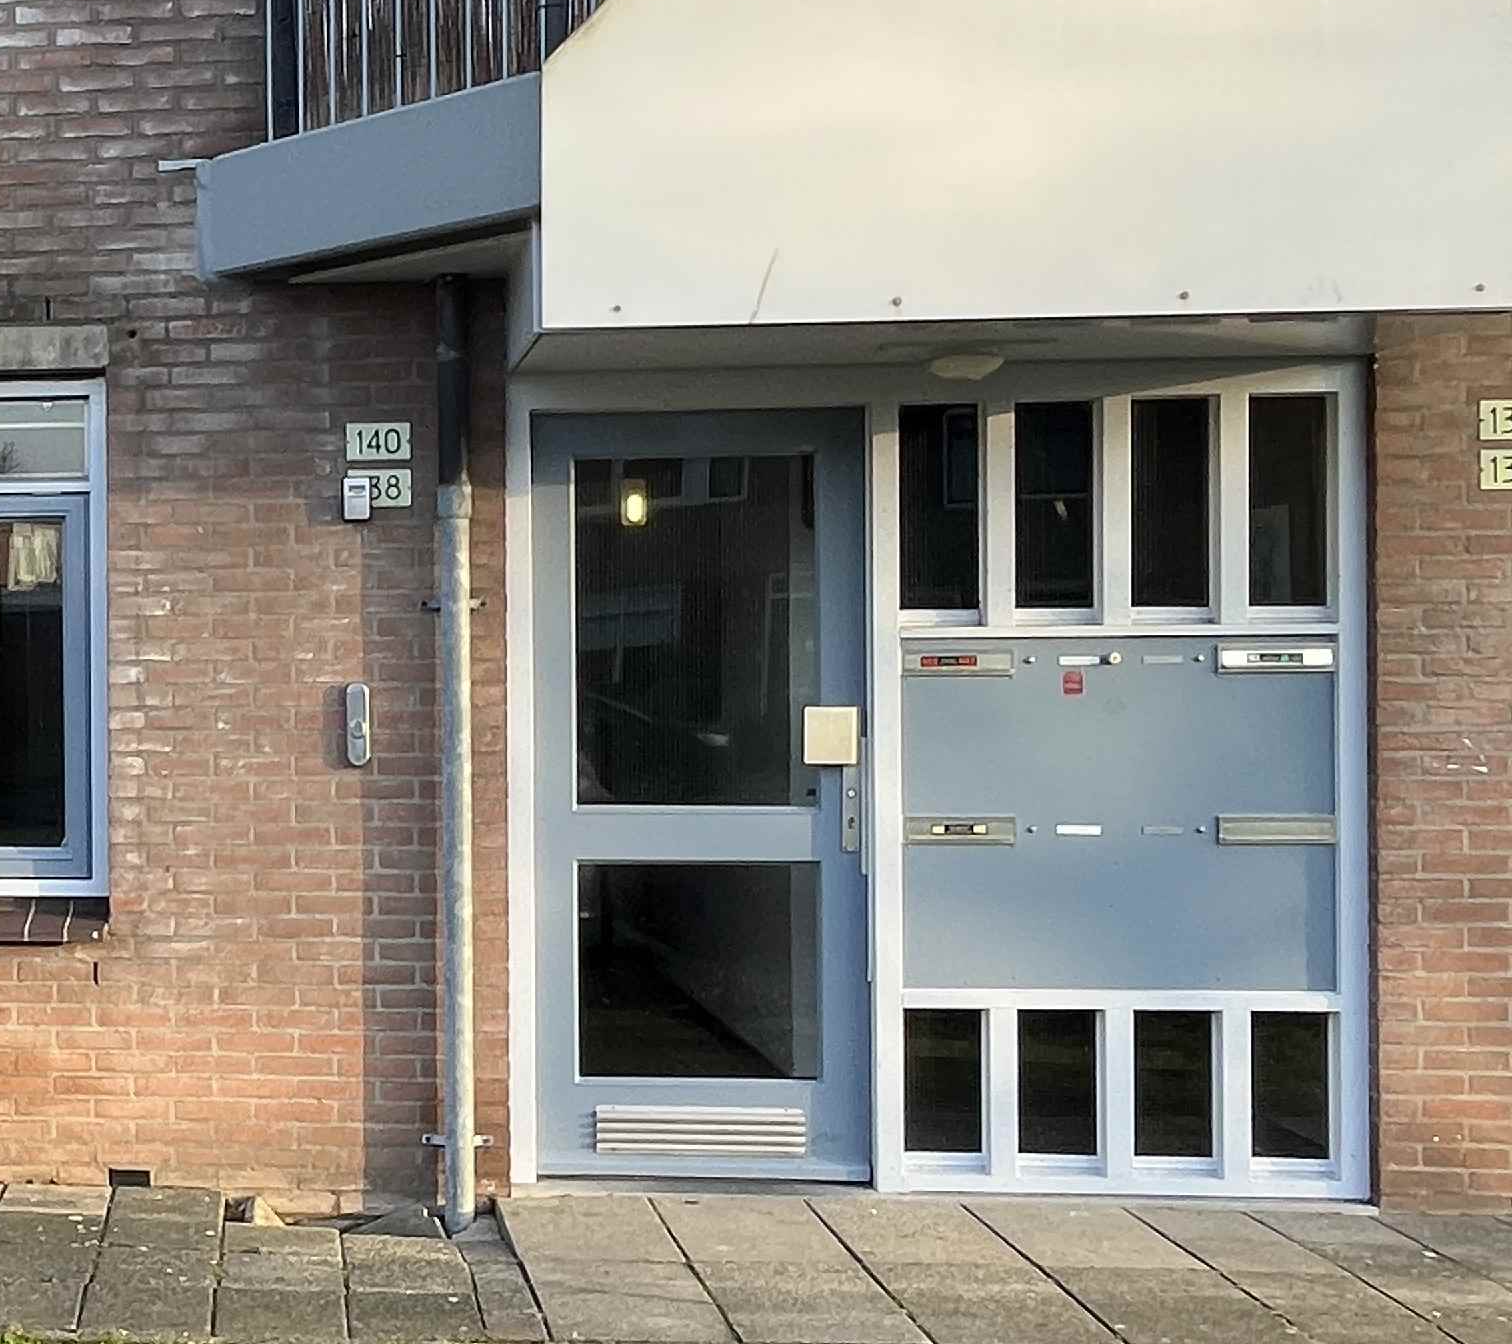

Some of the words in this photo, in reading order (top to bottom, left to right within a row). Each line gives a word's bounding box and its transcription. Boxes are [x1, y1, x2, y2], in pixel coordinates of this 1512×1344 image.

[1490, 406, 1512, 434] 13
[356, 428, 401, 455] 140
[1490, 455, 1512, 483] 13
[369, 474, 402, 500] 38
